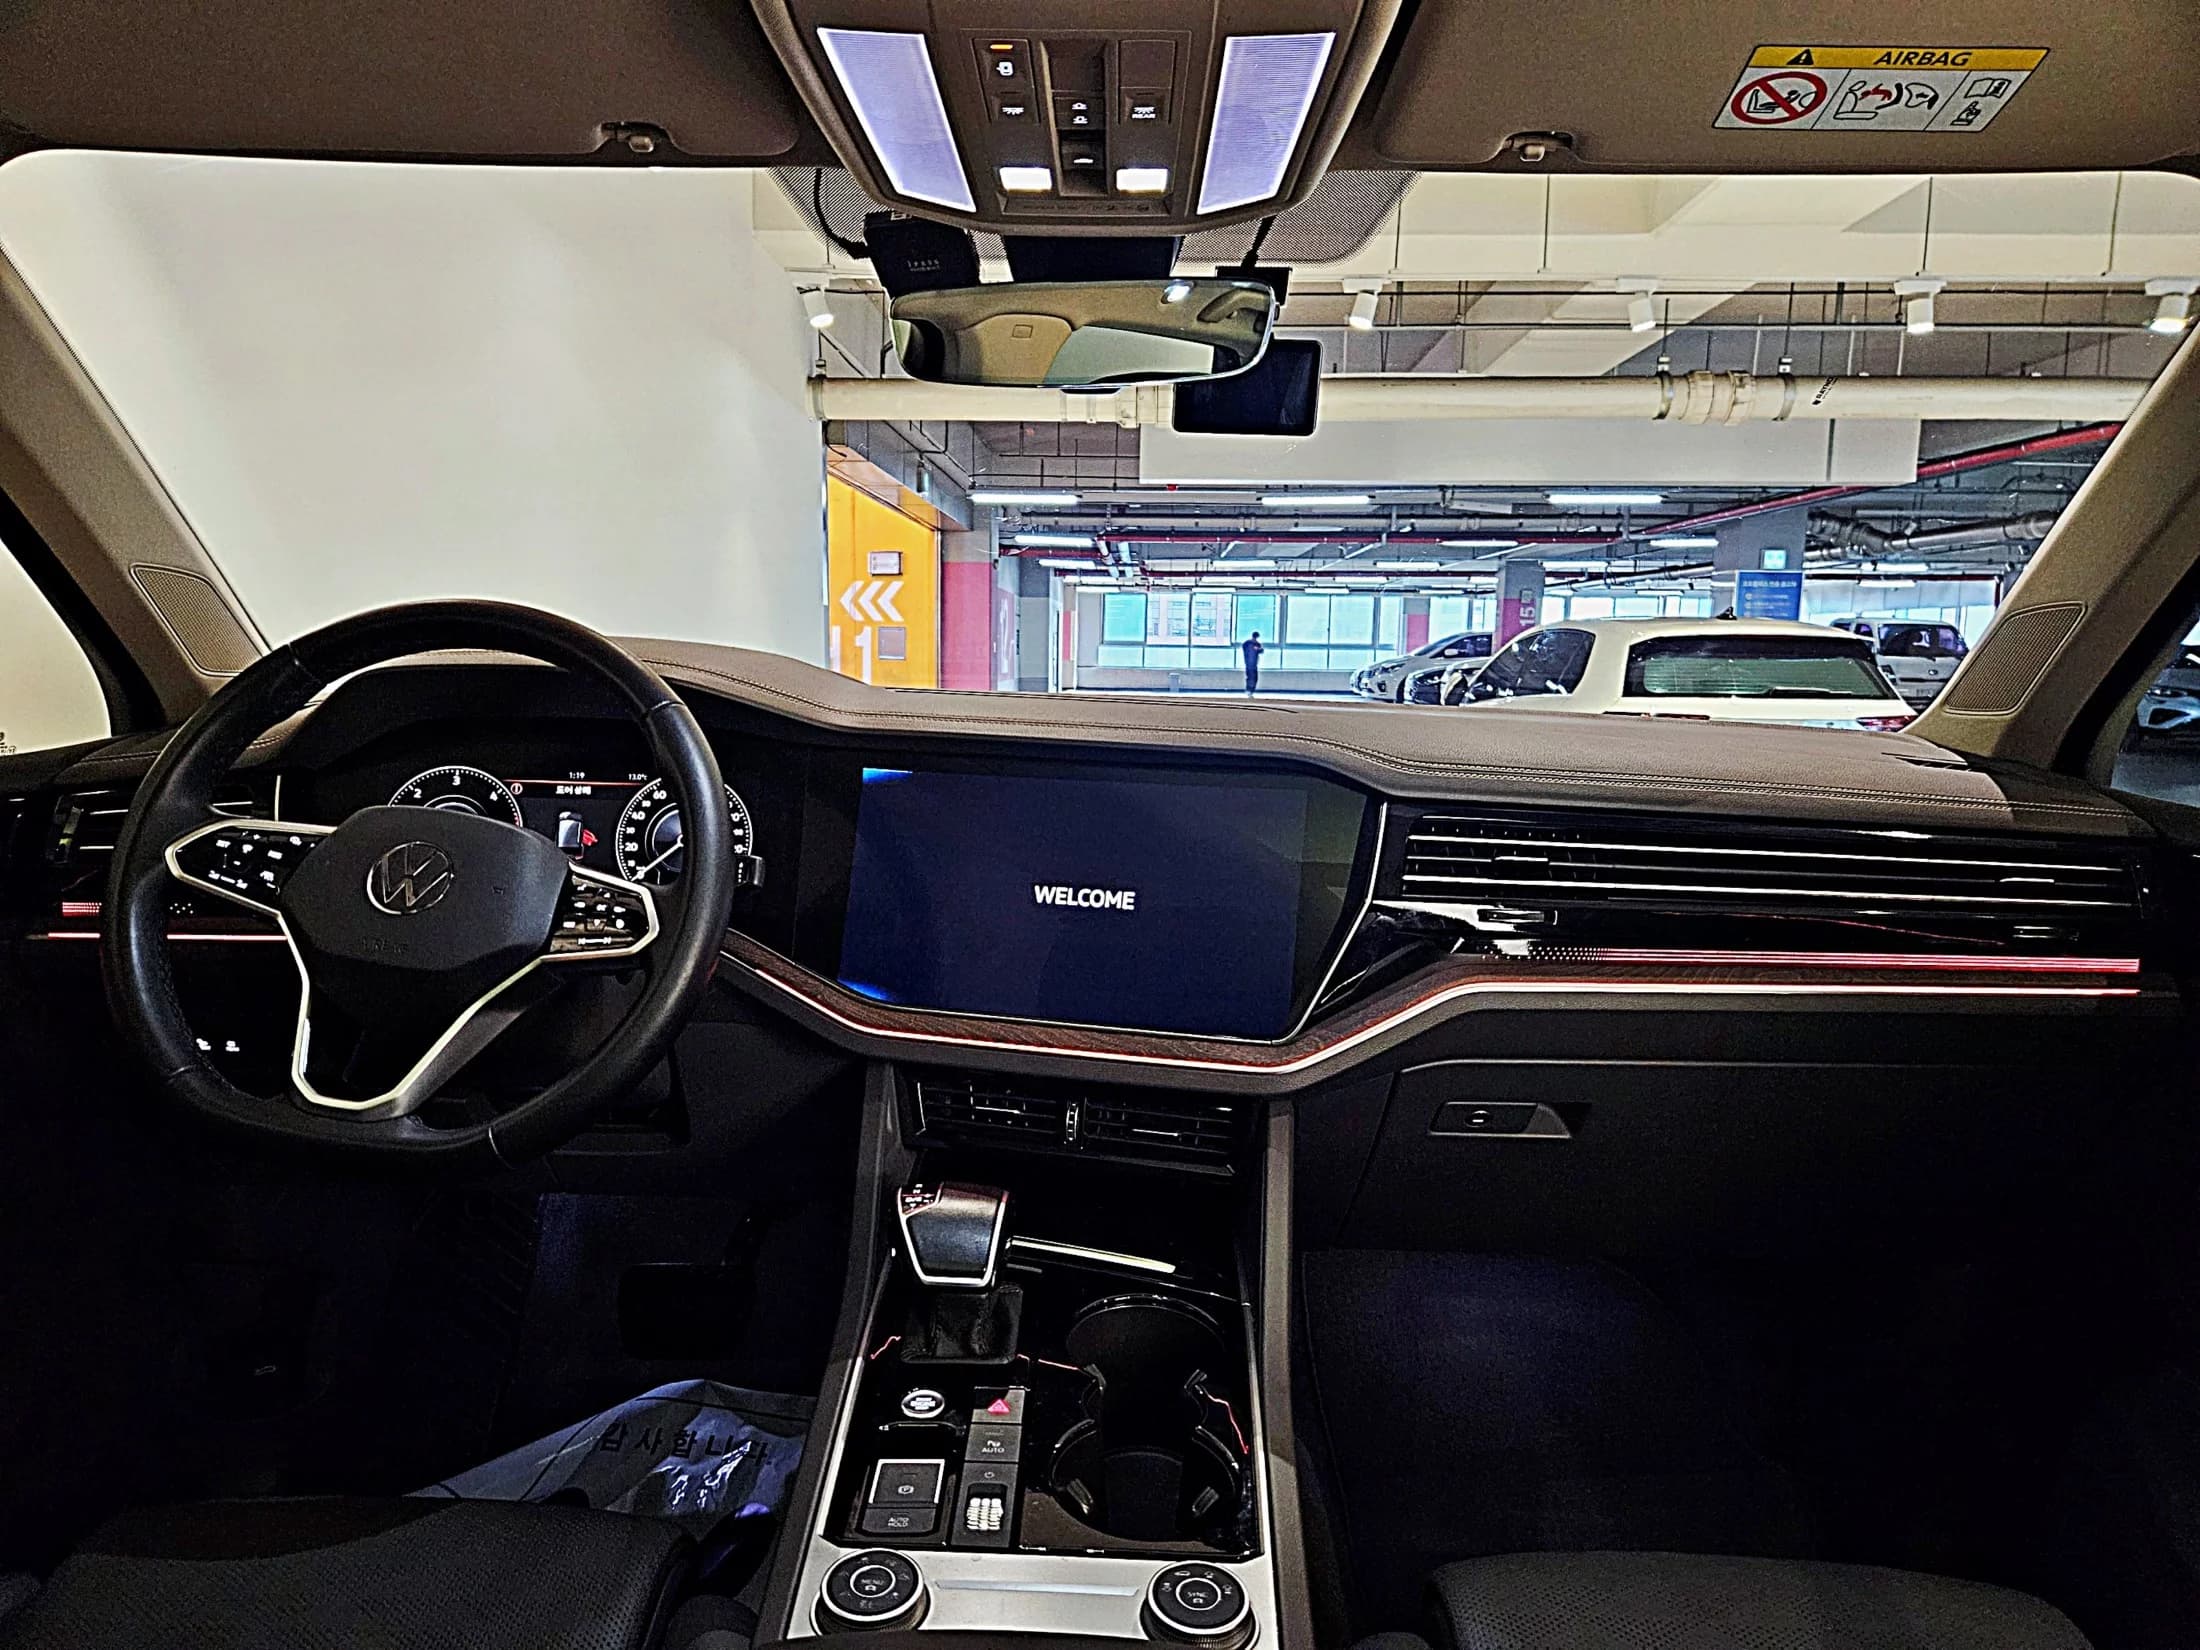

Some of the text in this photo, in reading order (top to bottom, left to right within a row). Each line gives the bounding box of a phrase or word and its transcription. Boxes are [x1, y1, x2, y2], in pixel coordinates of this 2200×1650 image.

[1873, 51, 1973, 67] AIRBAG
[1519, 606, 1536, 627] 15
[452, 775, 461, 786] 3
[569, 771, 586, 779] 1:19
[413, 788, 422, 799] 2
[555, 785, 573, 795] 도어
[652, 789, 668, 800] 60
[489, 791, 498, 801] 4
[631, 810, 646, 821] 40
[624, 841, 639, 852] 20
[1034, 884, 1136, 911] WELCOME
